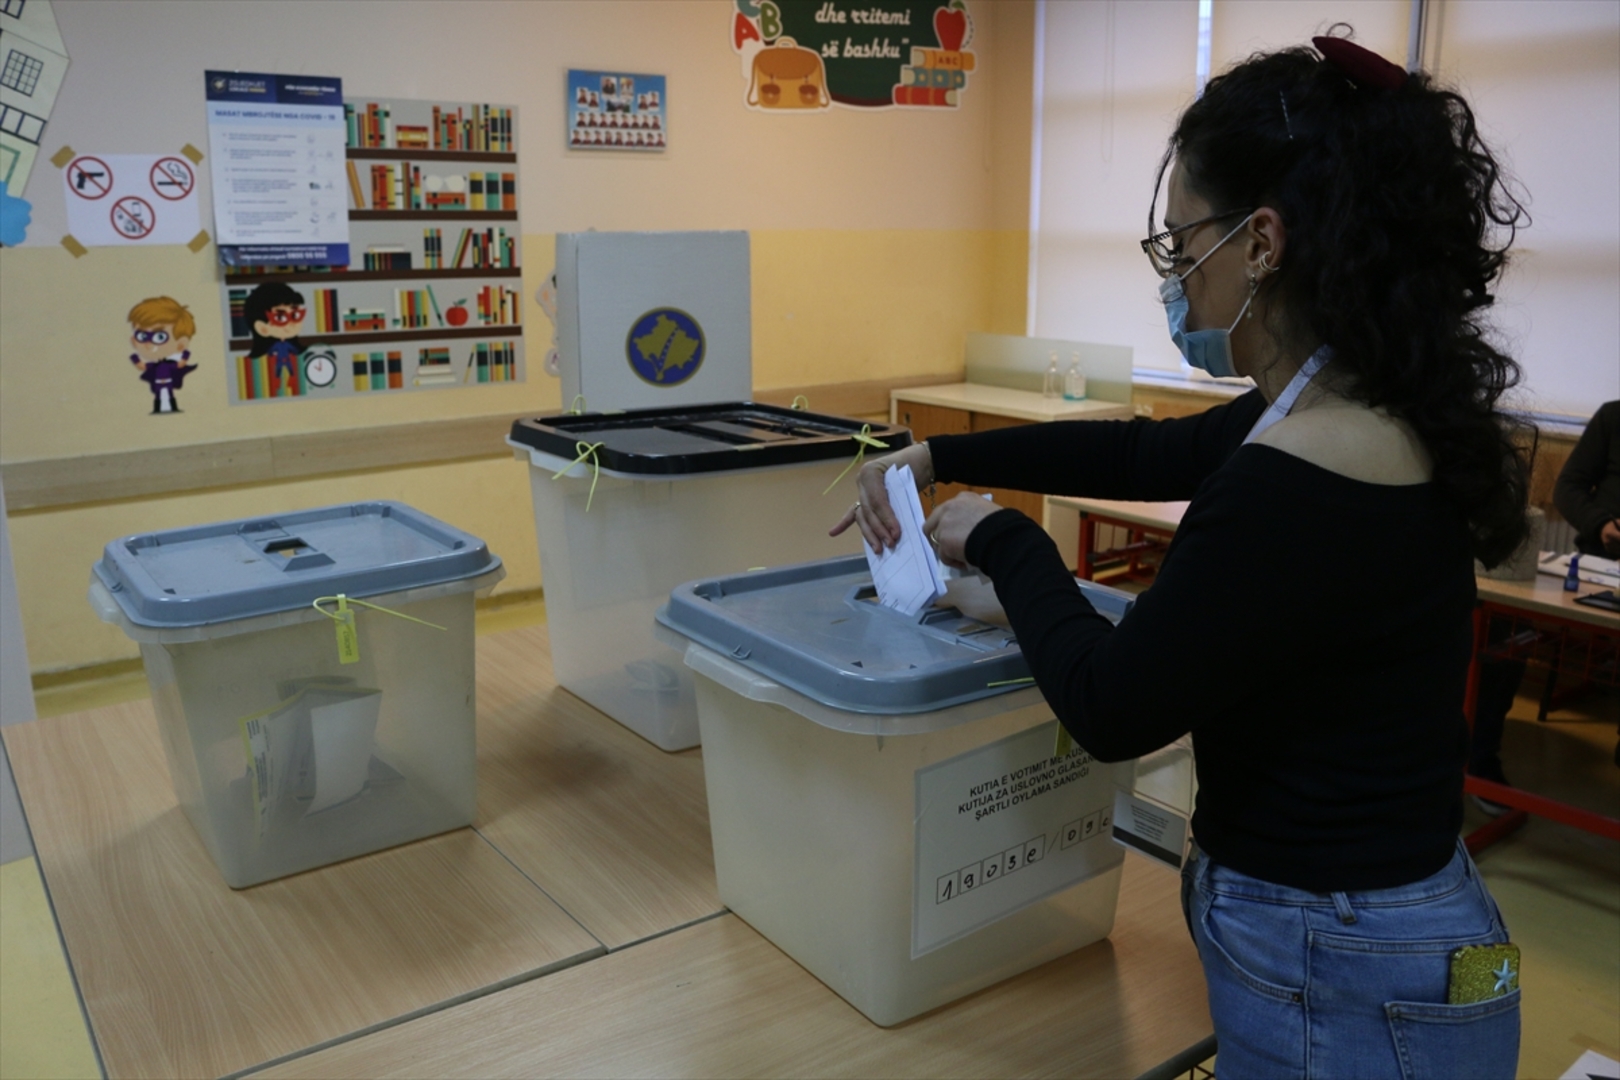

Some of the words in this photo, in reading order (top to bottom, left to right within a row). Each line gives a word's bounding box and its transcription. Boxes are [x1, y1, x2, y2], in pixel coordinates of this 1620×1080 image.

[815, 2, 847, 24] dhe
[851, 8, 911, 25] rritemi
[821, 40, 839, 58] së
[283, 112, 298, 120] NGA
[300, 113, 322, 121] COVID
[957, 795, 994, 815] KUTIJA
[995, 788, 1009, 800] ZA
[1010, 768, 1056, 794] USLOVNO
[969, 780, 1000, 798] KUTIA
[1001, 775, 1008, 786] E
[1010, 760, 1047, 781] VOTIMIT
[1049, 756, 1063, 768] ME
[974, 800, 1011, 822] ŞARTLI
[1011, 783, 1052, 806] OYLAMA
